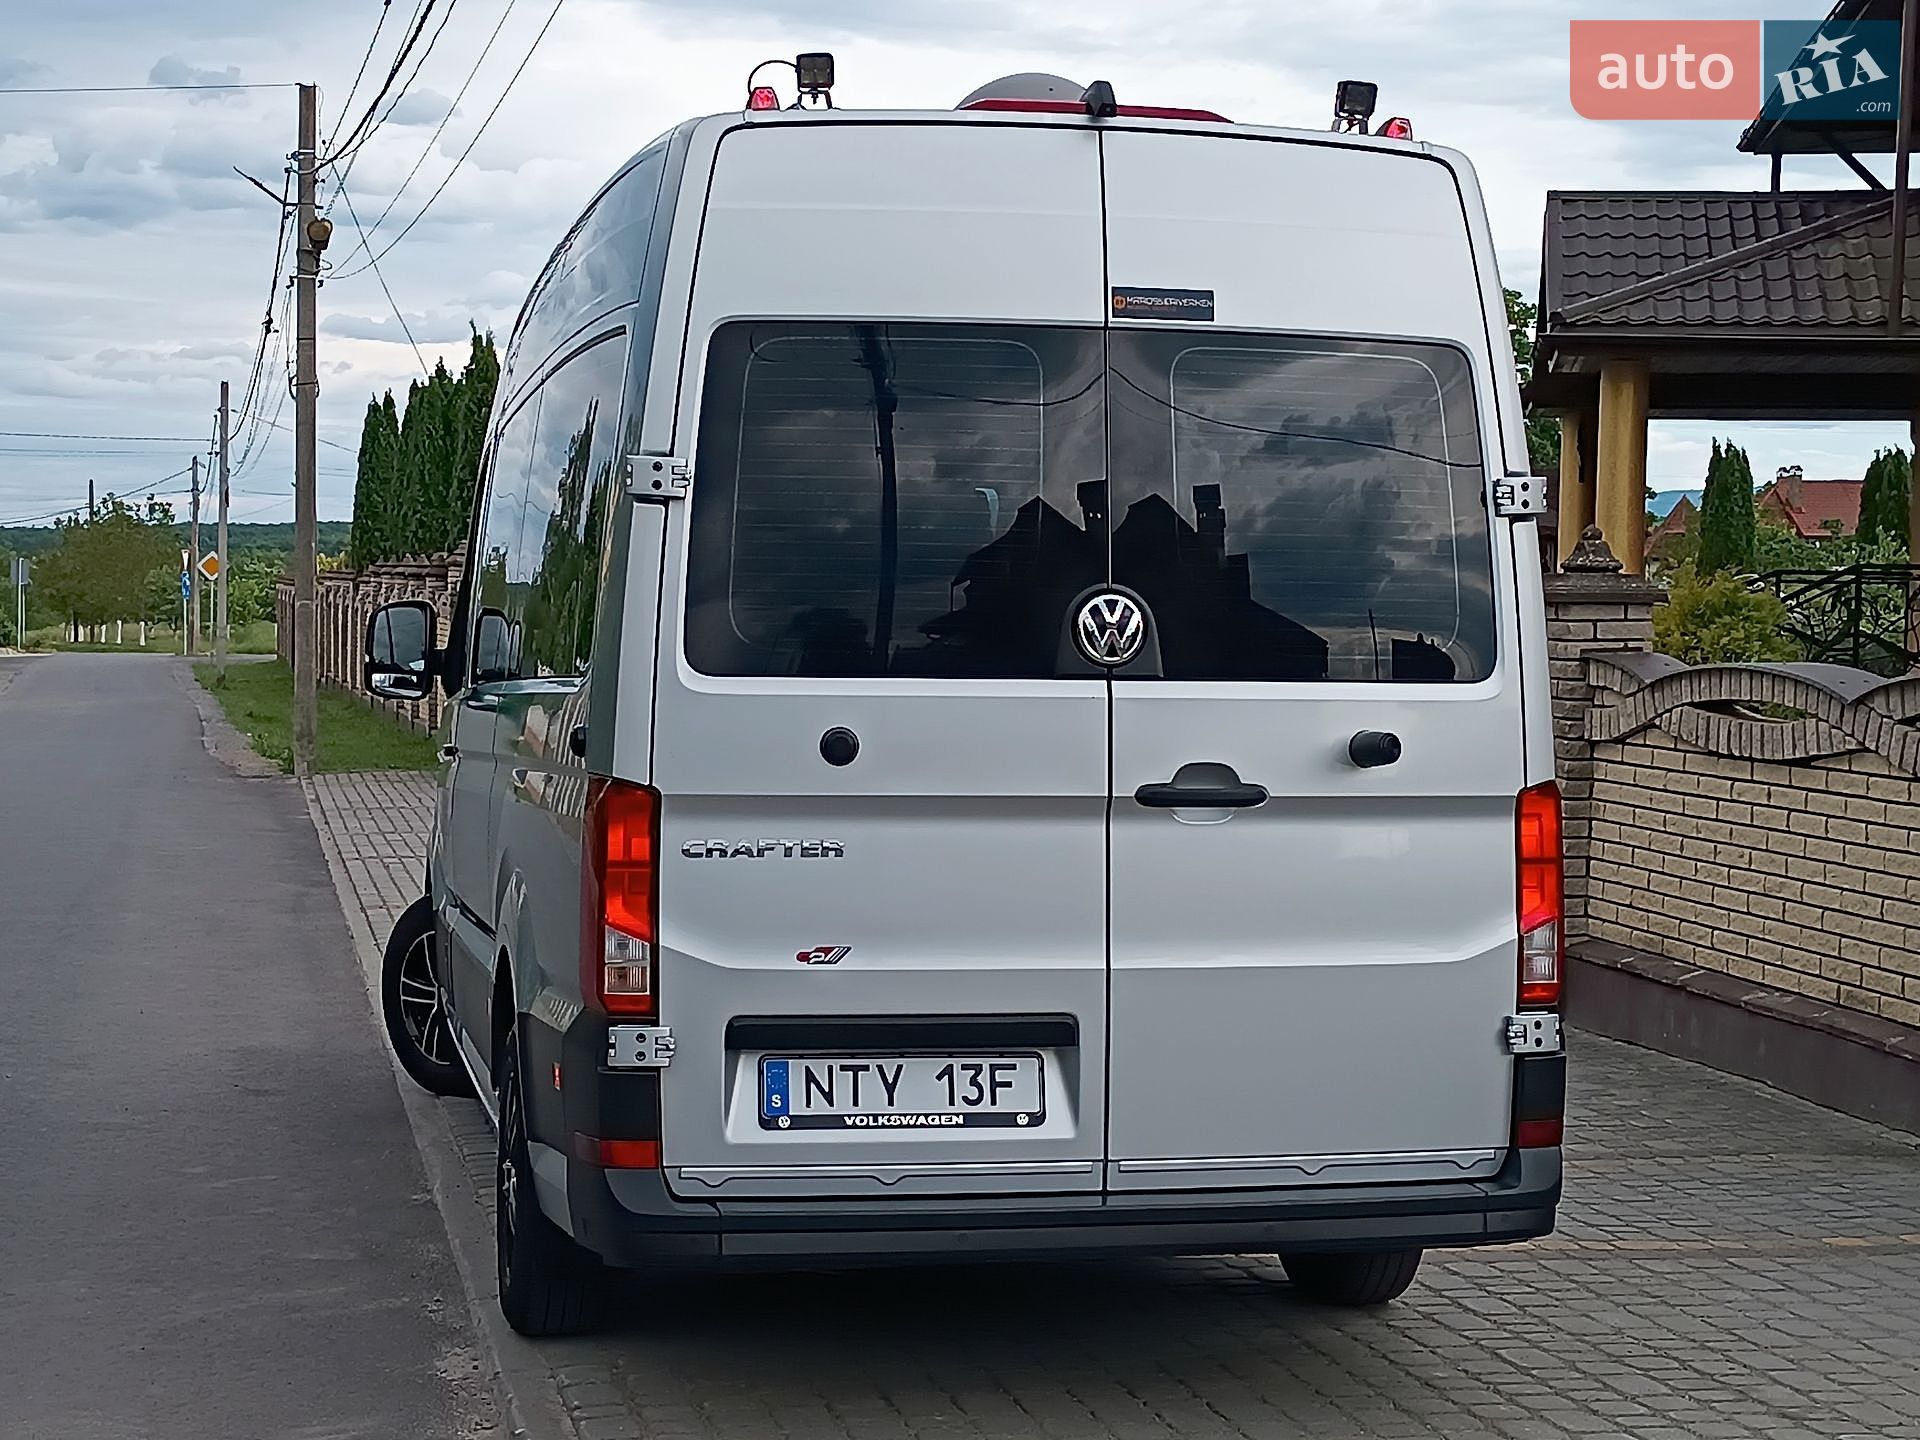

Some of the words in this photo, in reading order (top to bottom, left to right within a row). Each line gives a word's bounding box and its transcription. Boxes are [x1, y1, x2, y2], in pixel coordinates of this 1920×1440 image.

[1078, 594, 1143, 664] VW
[681, 838, 845, 859] CRAFTER
[804, 1063, 904, 1108] NTY
[935, 1063, 1018, 1107] 13F
[771, 1094, 782, 1108] S
[843, 1114, 964, 1127] VOLKSWAGEN
